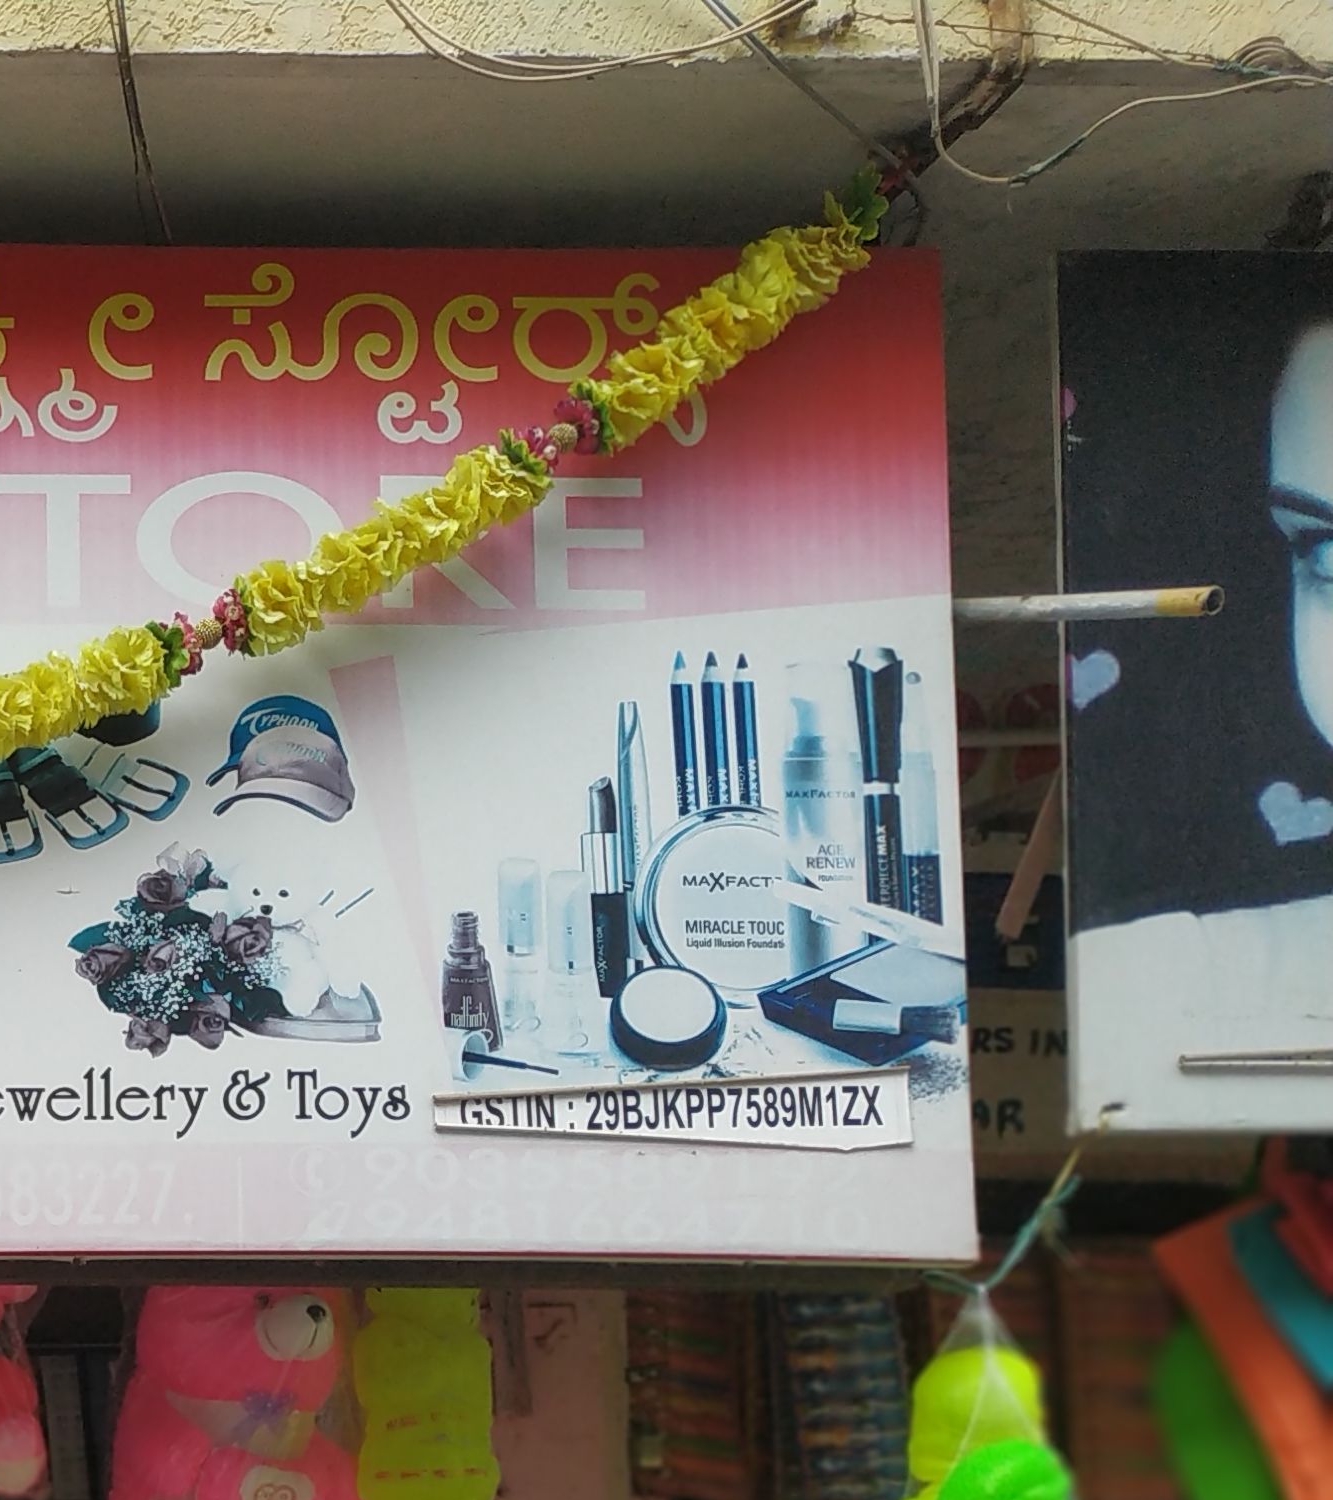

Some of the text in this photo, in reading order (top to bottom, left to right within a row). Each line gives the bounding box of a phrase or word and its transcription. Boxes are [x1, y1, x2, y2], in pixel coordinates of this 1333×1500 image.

[682, 872, 782, 892] MAXFACT
[685, 920, 745, 935] MIRACLE
[686, 937, 712, 950] Liquid
[714, 938, 745, 949] Illusion
[223, 1068, 271, 1122] &
[286, 1068, 413, 1139] Toys
[460, 1093, 556, 1128] GSTIN
[586, 1085, 885, 1132] 29BJKPP7589M1ZX
